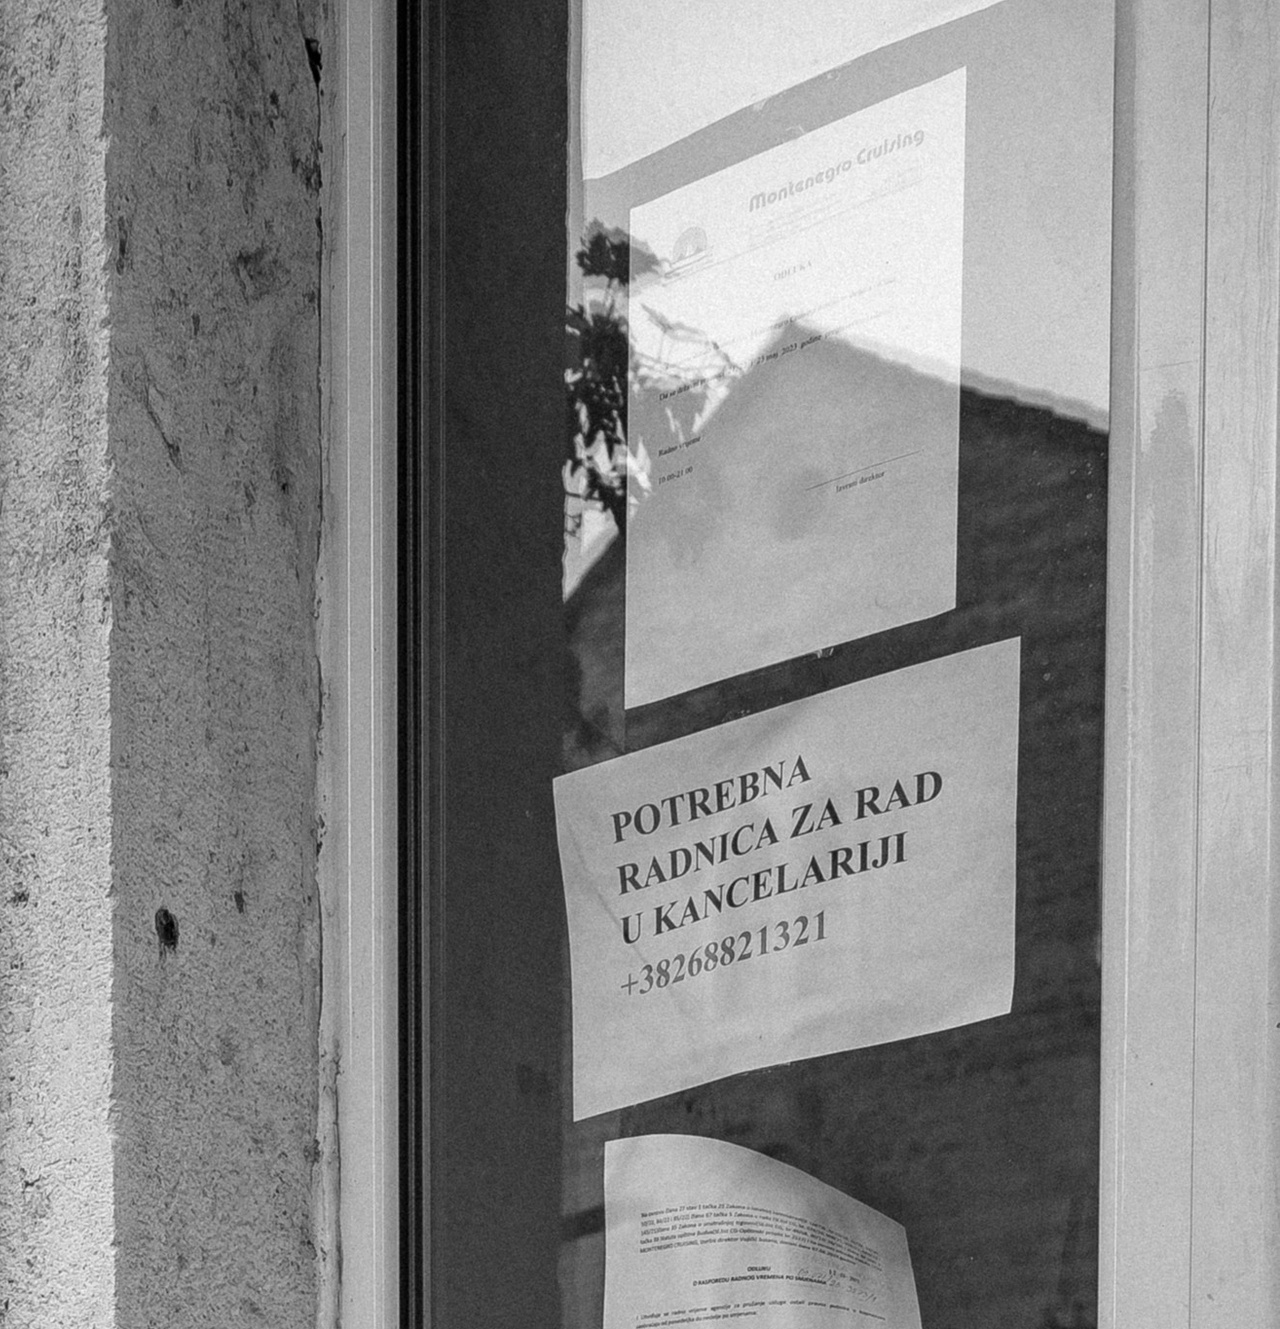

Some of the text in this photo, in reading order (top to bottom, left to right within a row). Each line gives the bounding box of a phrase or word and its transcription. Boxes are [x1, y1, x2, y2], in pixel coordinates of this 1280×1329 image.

[749, 129, 924, 213] Montenegro Cruising
[611, 754, 812, 844] POTREBNA
[616, 770, 943, 896] RADNICA ZA RAD
[621, 831, 908, 945] U KANCELARIJI
[620, 910, 828, 997] +38268821321
